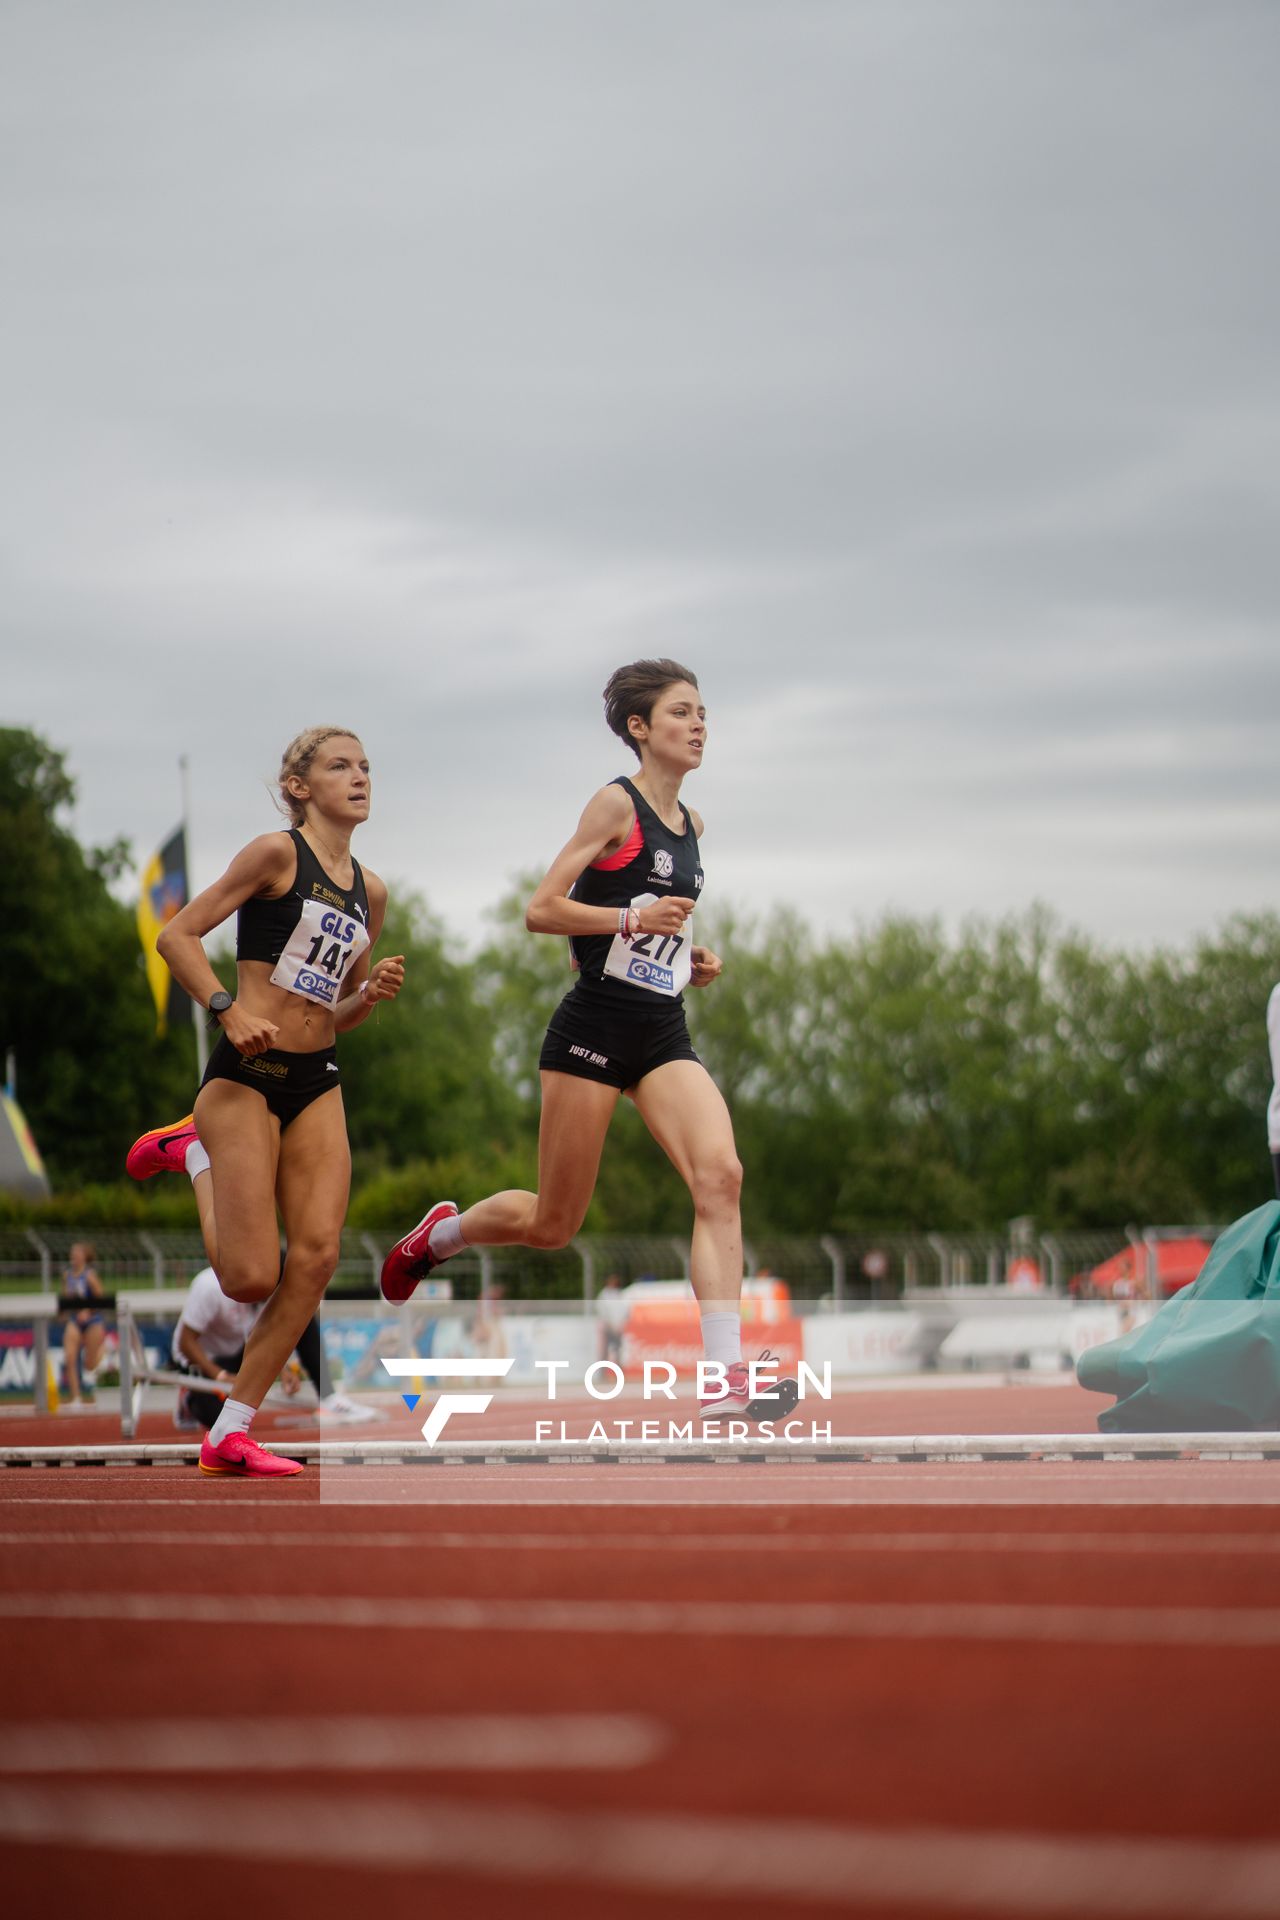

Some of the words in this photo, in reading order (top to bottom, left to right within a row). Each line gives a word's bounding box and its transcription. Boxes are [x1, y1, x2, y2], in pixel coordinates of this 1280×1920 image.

[320, 912, 356, 943] GLS
[304, 934, 353, 979] 141
[630, 933, 684, 966] 277
[650, 967, 672, 984] PLAN
[568, 1044, 591, 1060] JUST
[589, 1052, 609, 1066] RUN
